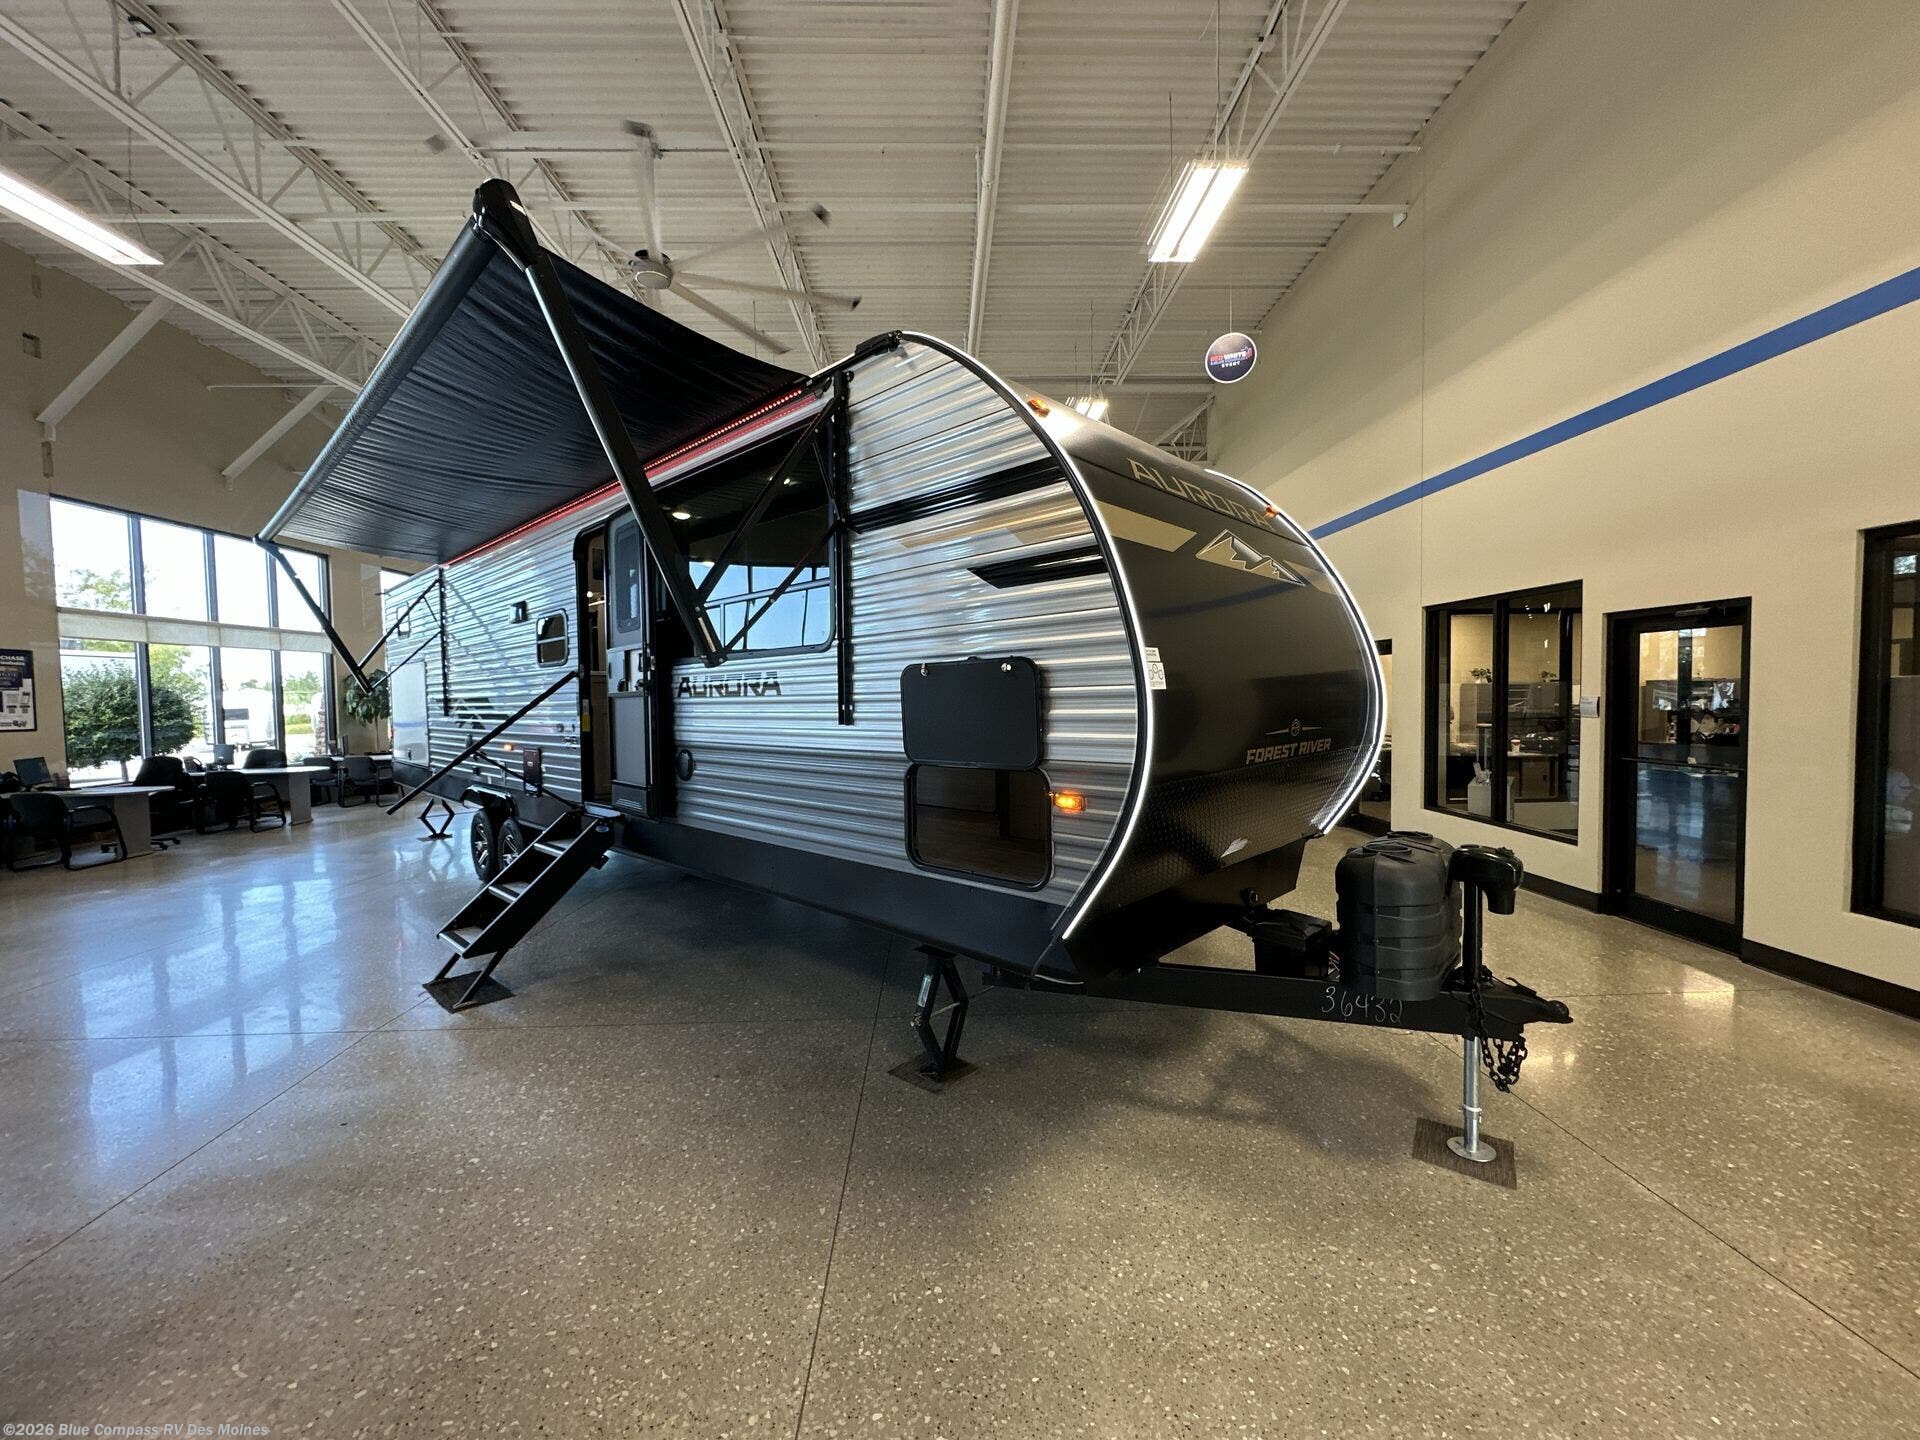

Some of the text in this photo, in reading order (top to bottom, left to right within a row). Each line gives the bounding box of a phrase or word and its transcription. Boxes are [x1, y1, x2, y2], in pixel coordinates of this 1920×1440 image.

[1127, 457, 1276, 532] AURORA
[677, 670, 782, 698] AURORA
[1245, 737, 1332, 765] FOREST RIVER
[1320, 985, 1404, 1024] 36432
